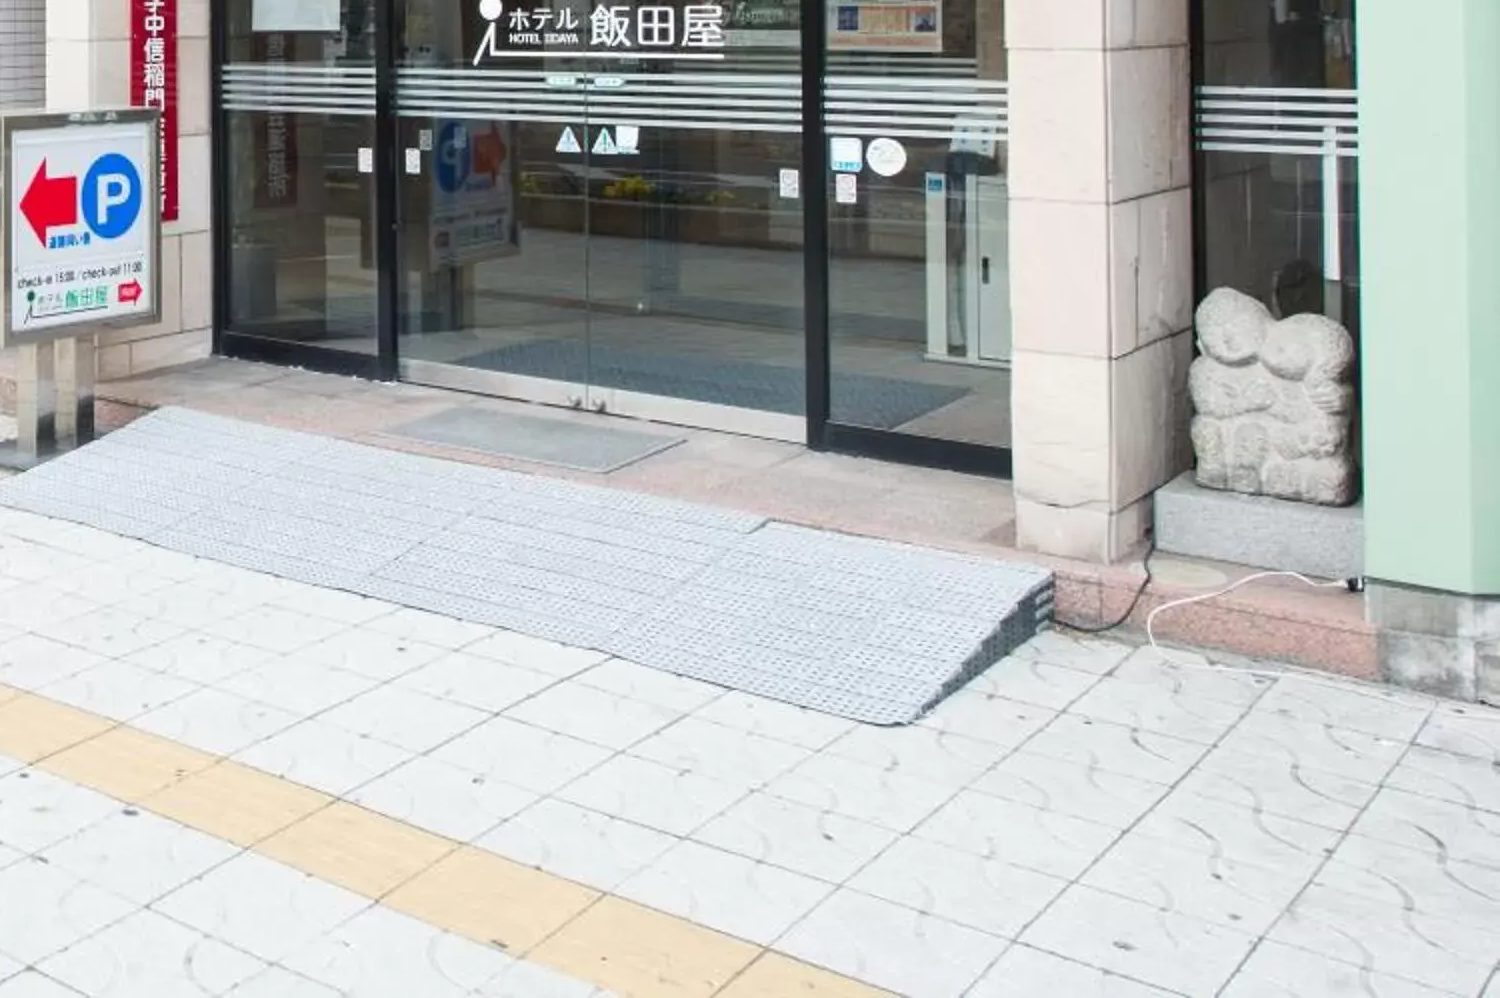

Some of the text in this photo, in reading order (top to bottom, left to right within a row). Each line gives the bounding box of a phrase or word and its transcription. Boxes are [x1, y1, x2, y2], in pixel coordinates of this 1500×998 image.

[508, 7, 579, 31] ホテル
[589, 4, 725, 47] 飯田屋
[508, 32, 542, 45] HOTEL
[97, 173, 131, 225] P
